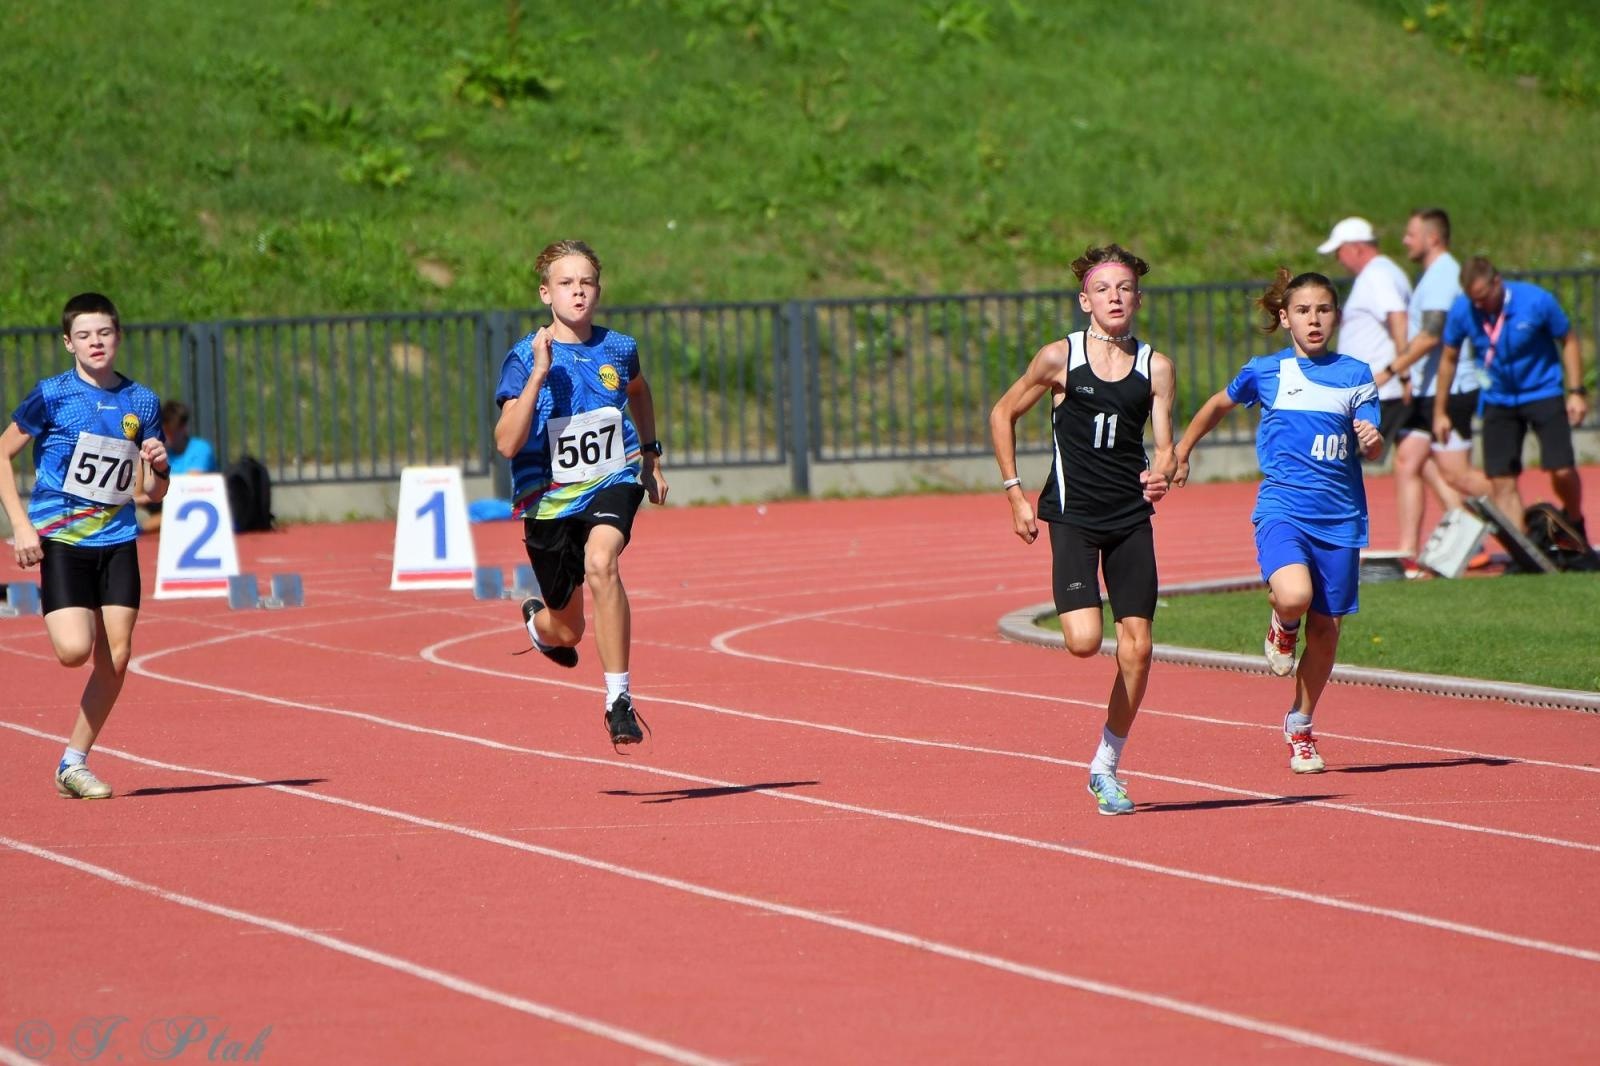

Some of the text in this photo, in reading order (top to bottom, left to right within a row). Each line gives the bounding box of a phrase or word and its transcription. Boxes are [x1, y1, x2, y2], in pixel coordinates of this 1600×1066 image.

[557, 424, 616, 469] 567
[1094, 412, 1118, 448] 11
[1311, 433, 1348, 461] 403
[74, 452, 133, 492] 570
[176, 500, 221, 570] 2
[416, 490, 447, 559] 1
